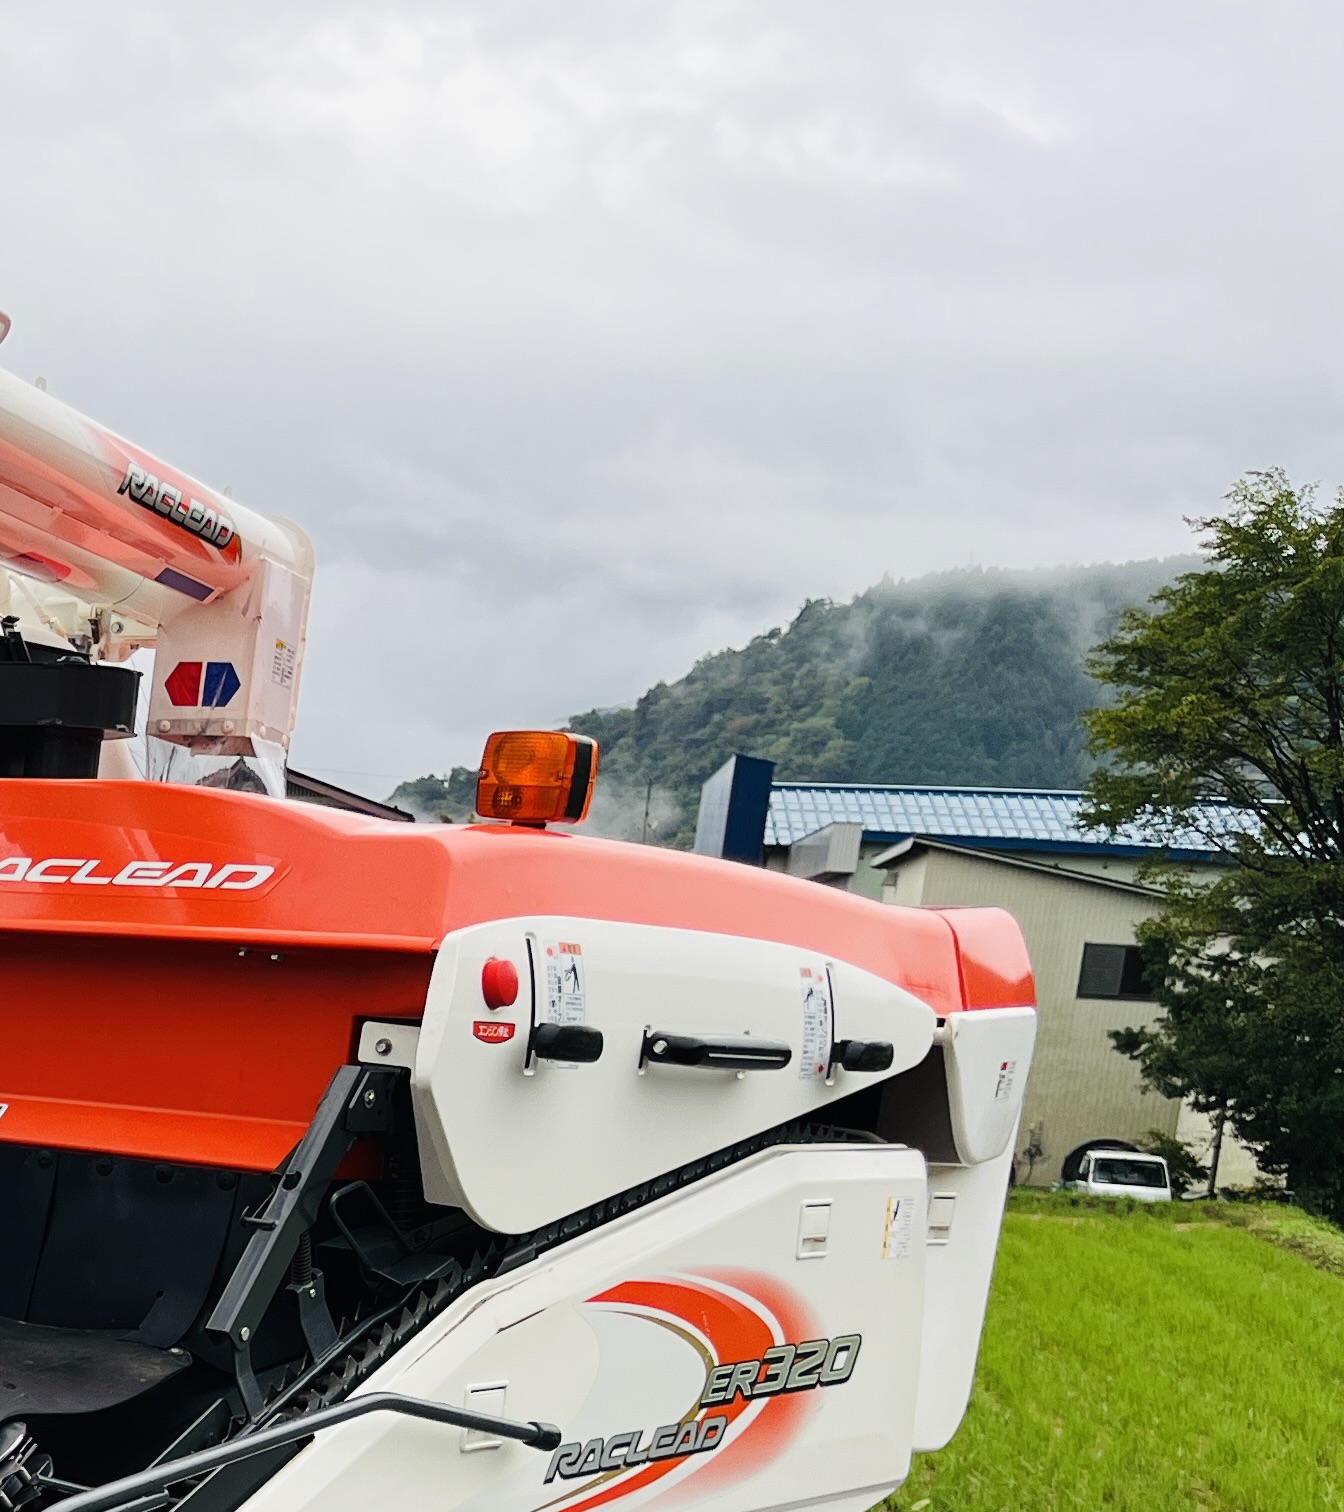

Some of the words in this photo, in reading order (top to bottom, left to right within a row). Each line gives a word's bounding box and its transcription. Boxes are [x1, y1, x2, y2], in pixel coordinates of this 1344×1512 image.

[117, 462, 235, 550] RACLEAD
[699, 1333, 863, 1408] ER320
[543, 1415, 729, 1485] RACLEAD
